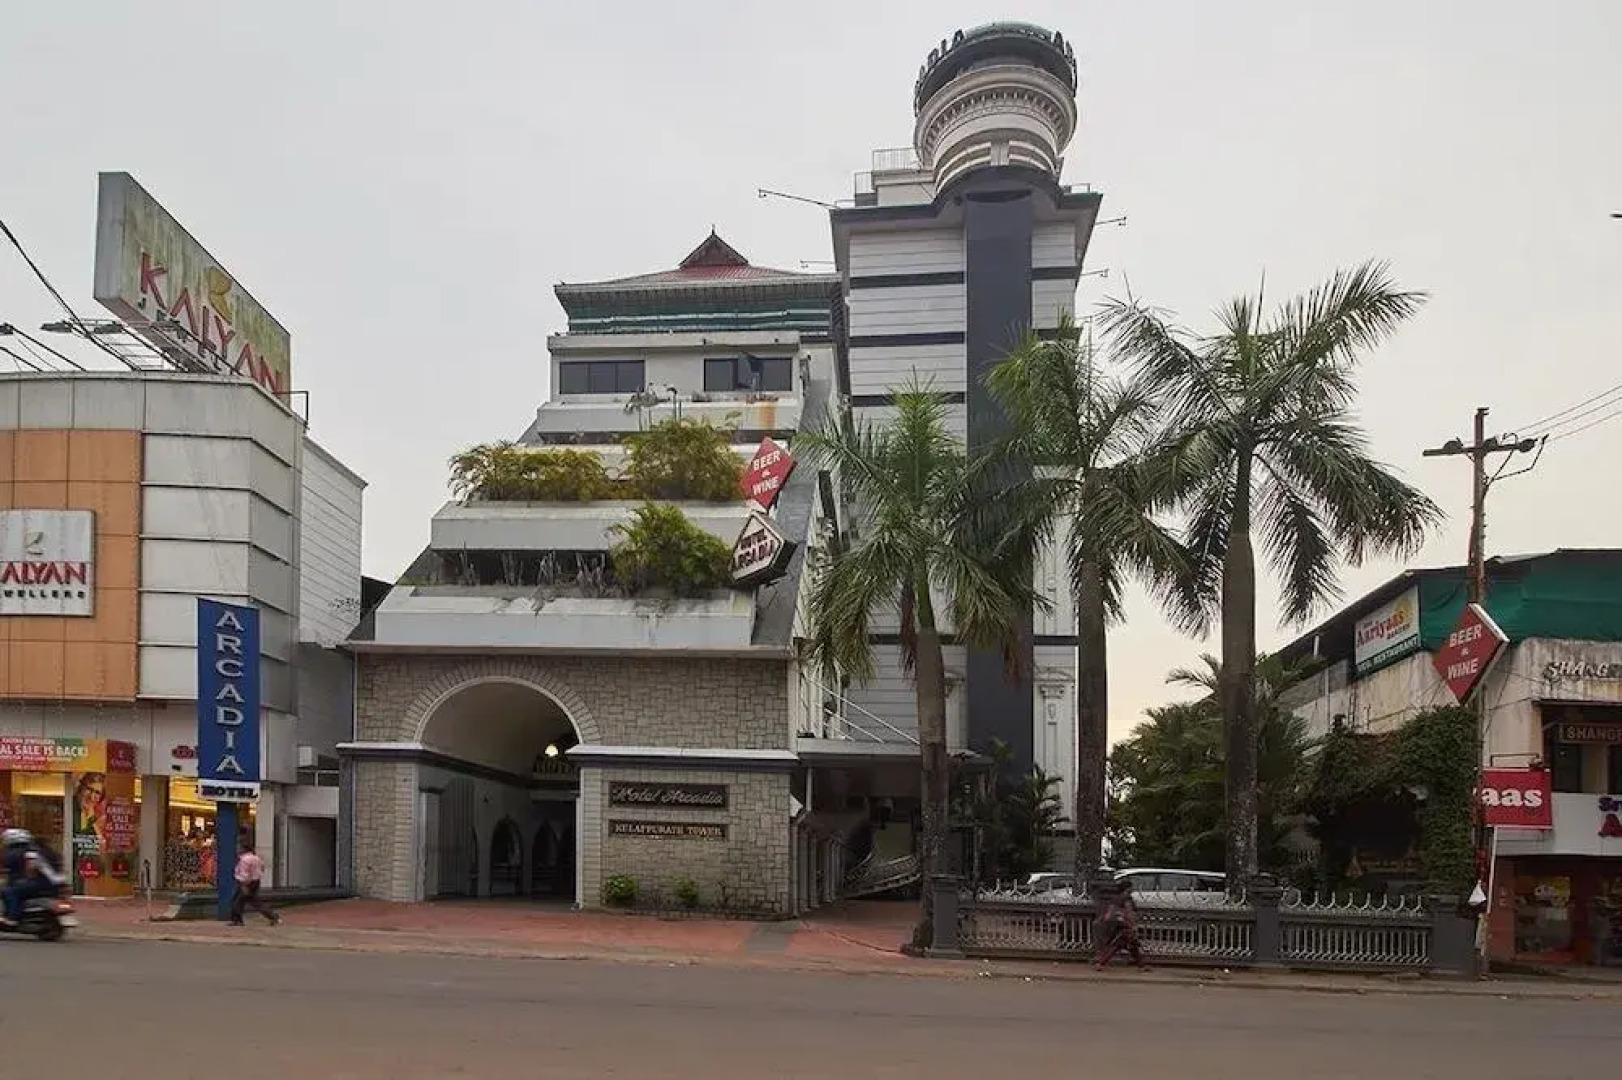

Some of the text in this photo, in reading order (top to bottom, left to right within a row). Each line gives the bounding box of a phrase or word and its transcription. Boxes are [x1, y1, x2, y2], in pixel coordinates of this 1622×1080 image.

[139, 251, 283, 396] KALYAN
[752, 450, 781, 472] BEER
[752, 476, 780, 496] WINE
[1449, 623, 1482, 649] BEER
[1447, 657, 1479, 680] WINE
[215, 610, 246, 776] ARCADIA
[15, 745, 40, 756] SALE
[43, 745, 54, 756] IS
